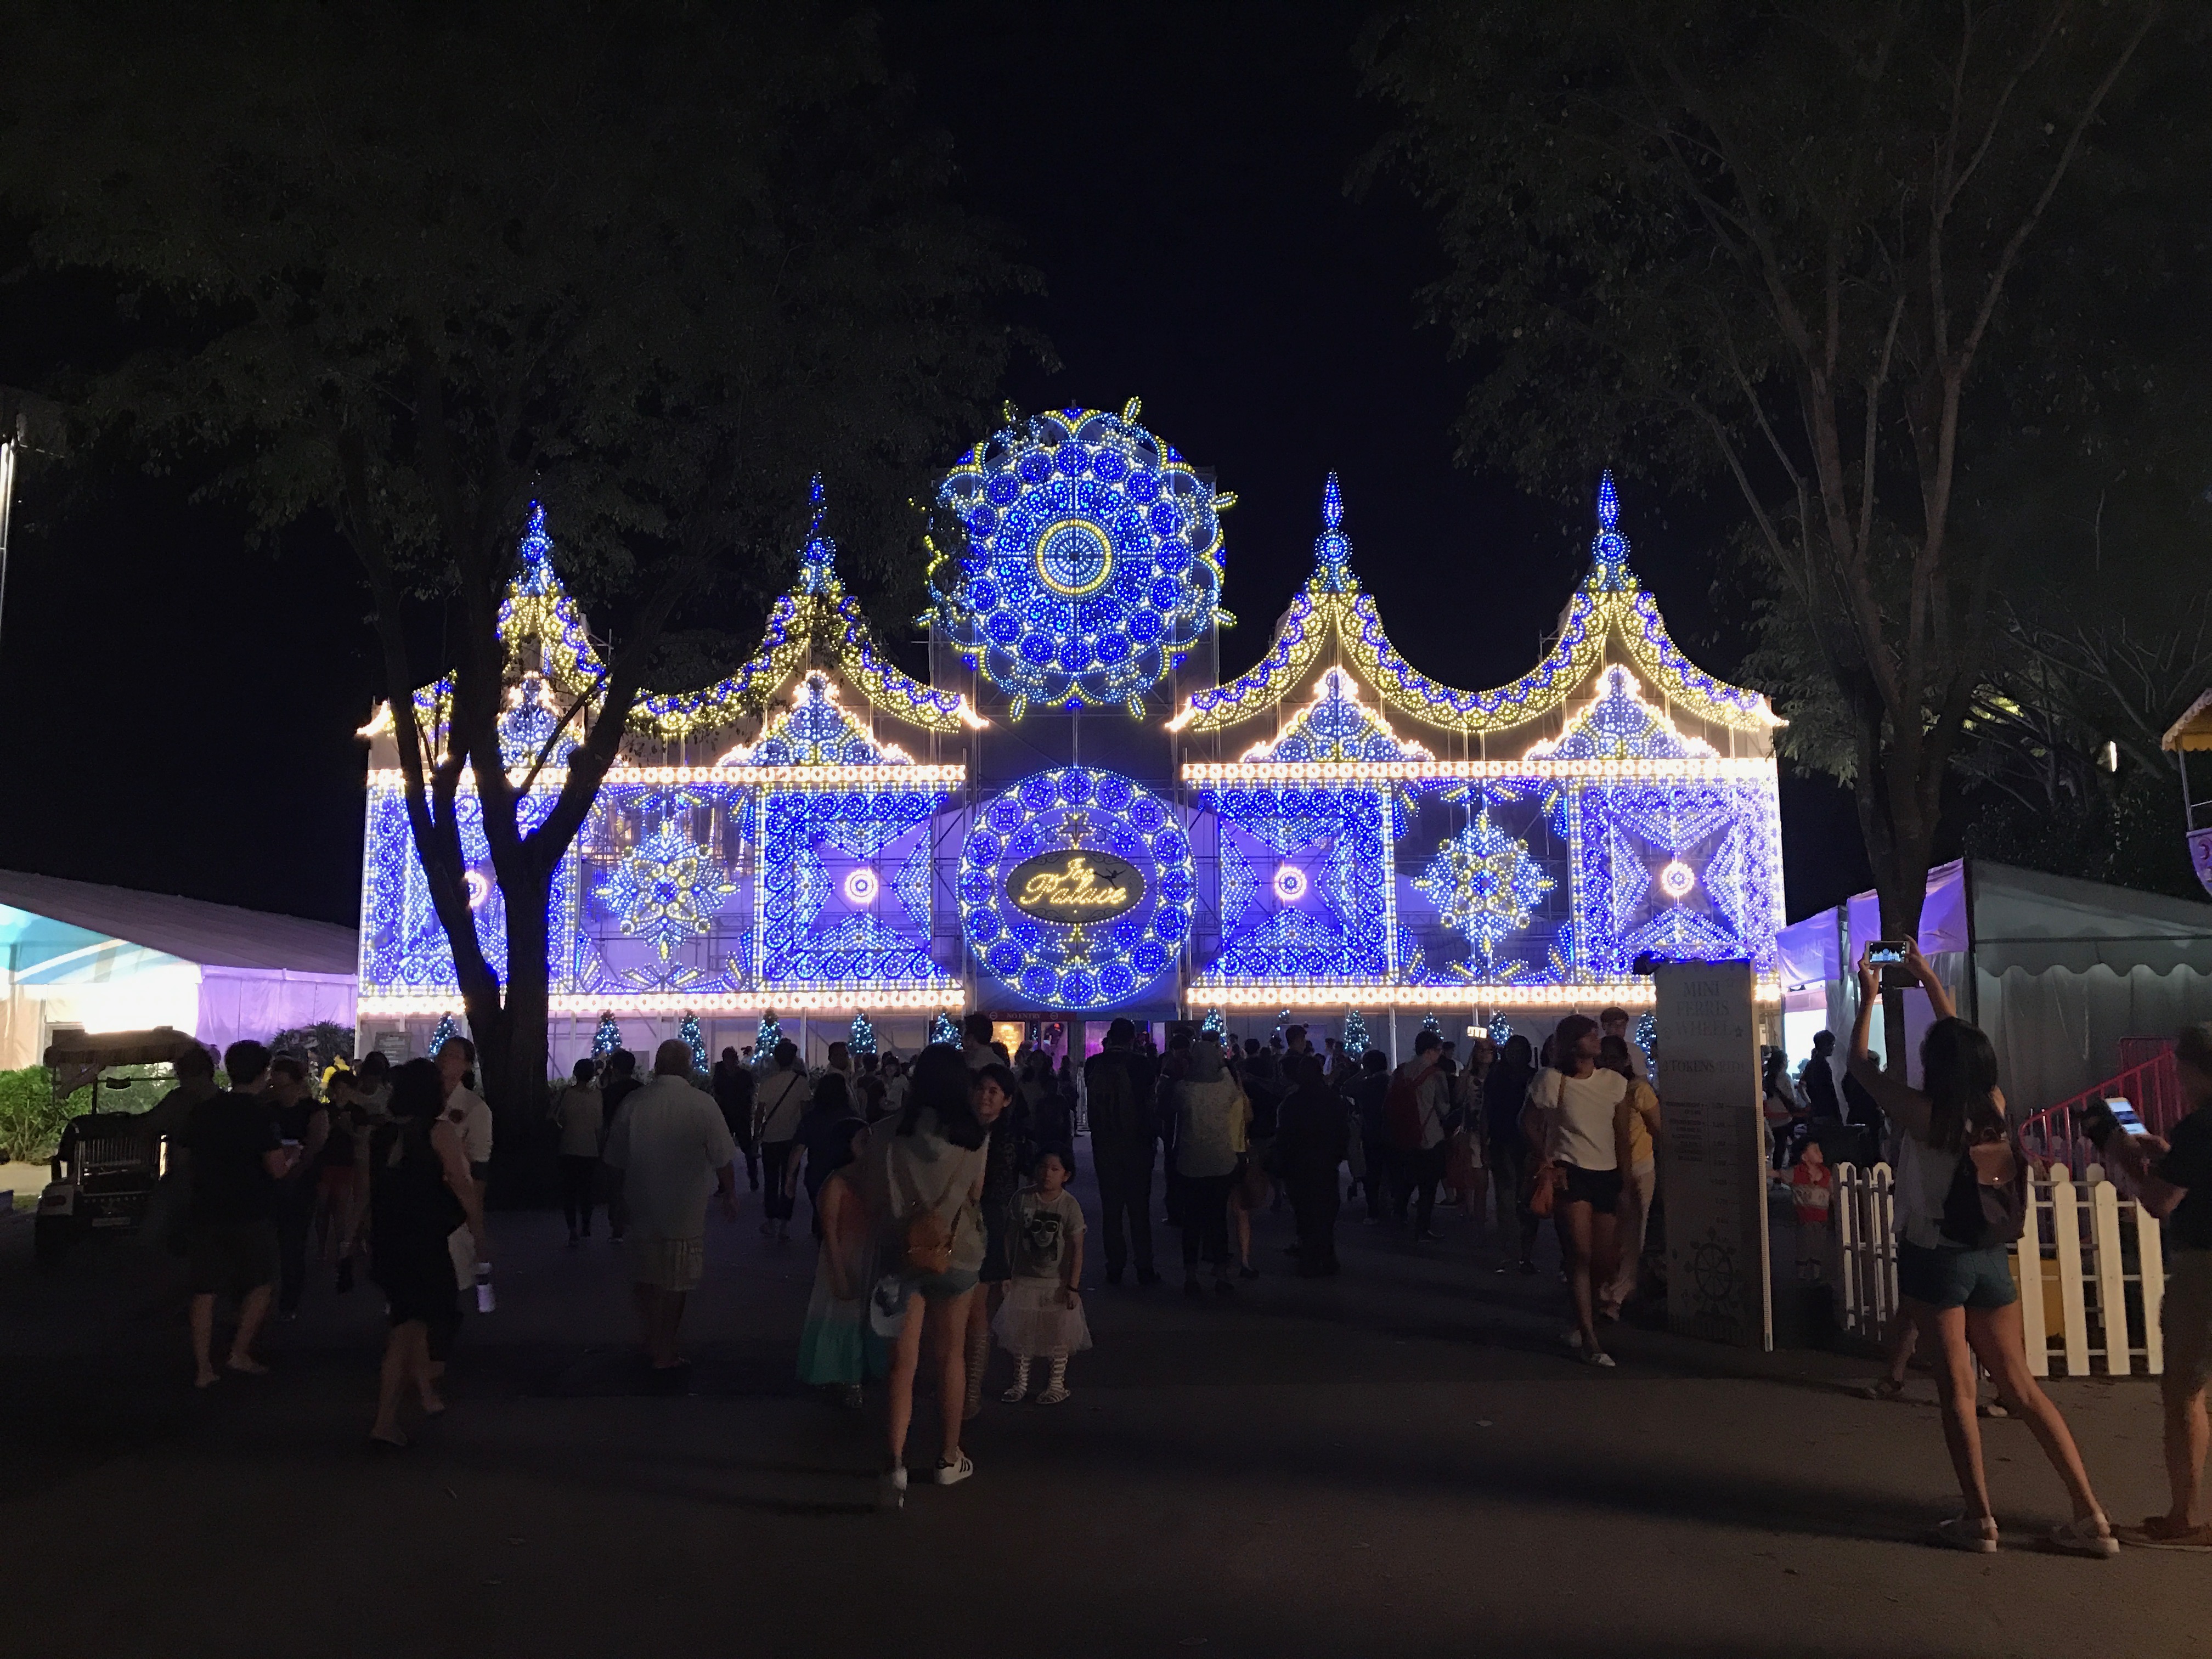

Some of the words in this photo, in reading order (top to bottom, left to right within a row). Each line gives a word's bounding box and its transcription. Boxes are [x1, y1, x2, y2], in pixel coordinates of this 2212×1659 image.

[1019, 873, 1126, 905] Palace
[1684, 980, 1720, 997] MINI
[1676, 1000, 1729, 1017] FERRIS
